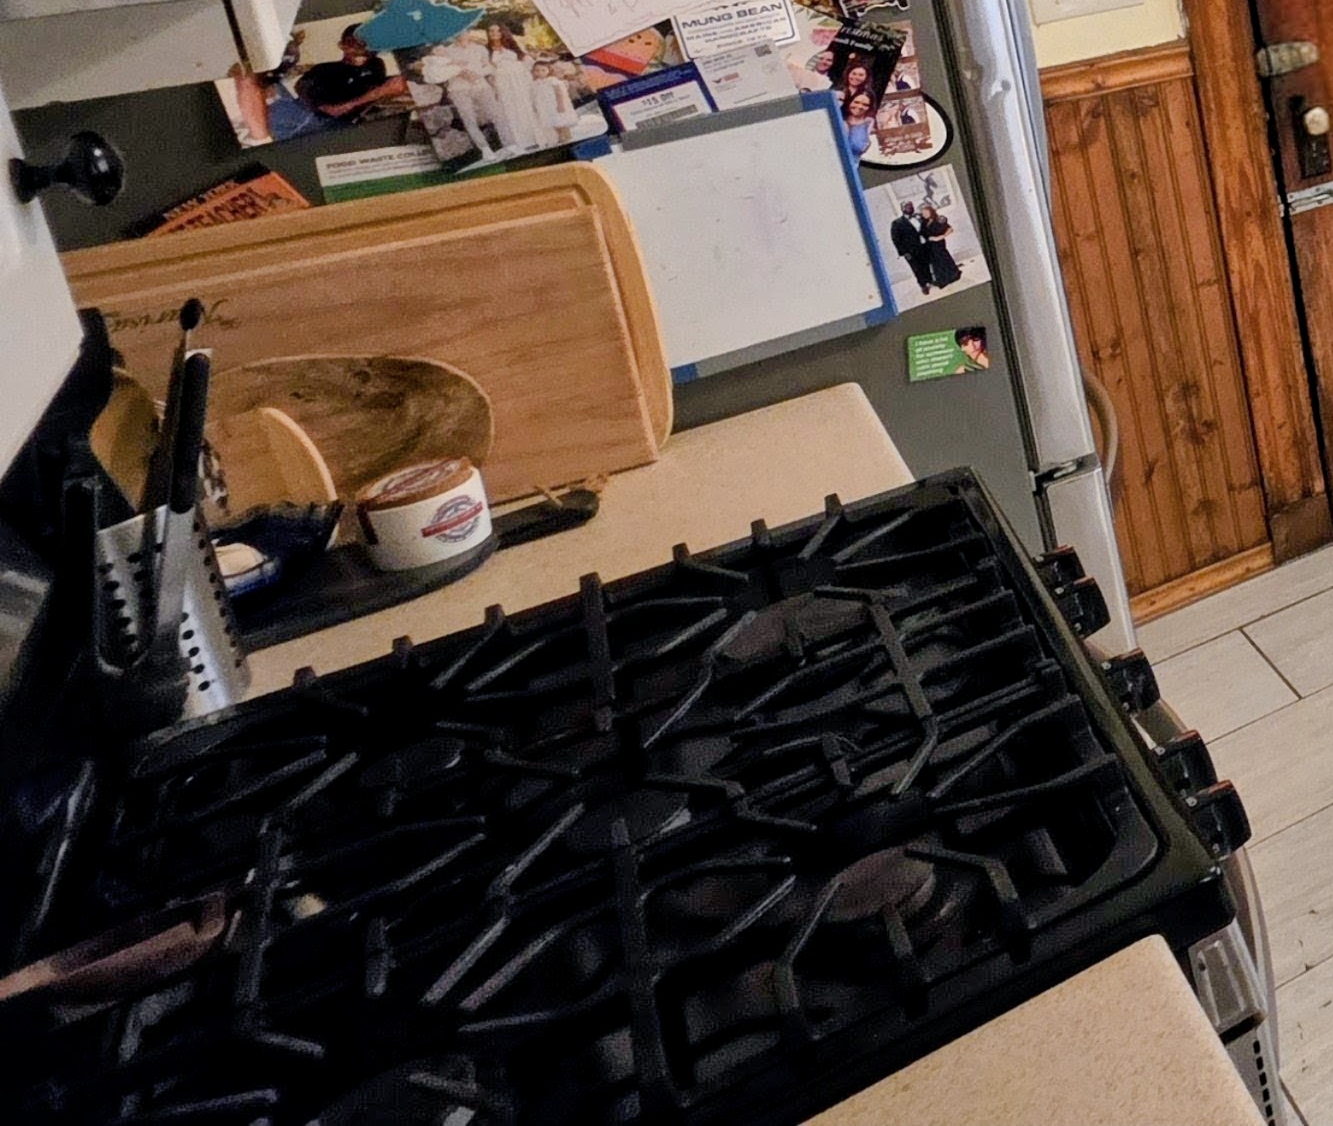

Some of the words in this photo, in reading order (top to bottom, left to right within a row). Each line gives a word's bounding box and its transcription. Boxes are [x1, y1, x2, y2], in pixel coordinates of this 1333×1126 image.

[681, 12, 733, 29] MUNG
[735, 2, 783, 18] BEAN
[734, 17, 787, 32] AMERICAN
[326, 160, 356, 170] FOOD
[359, 155, 395, 165] WASTE
